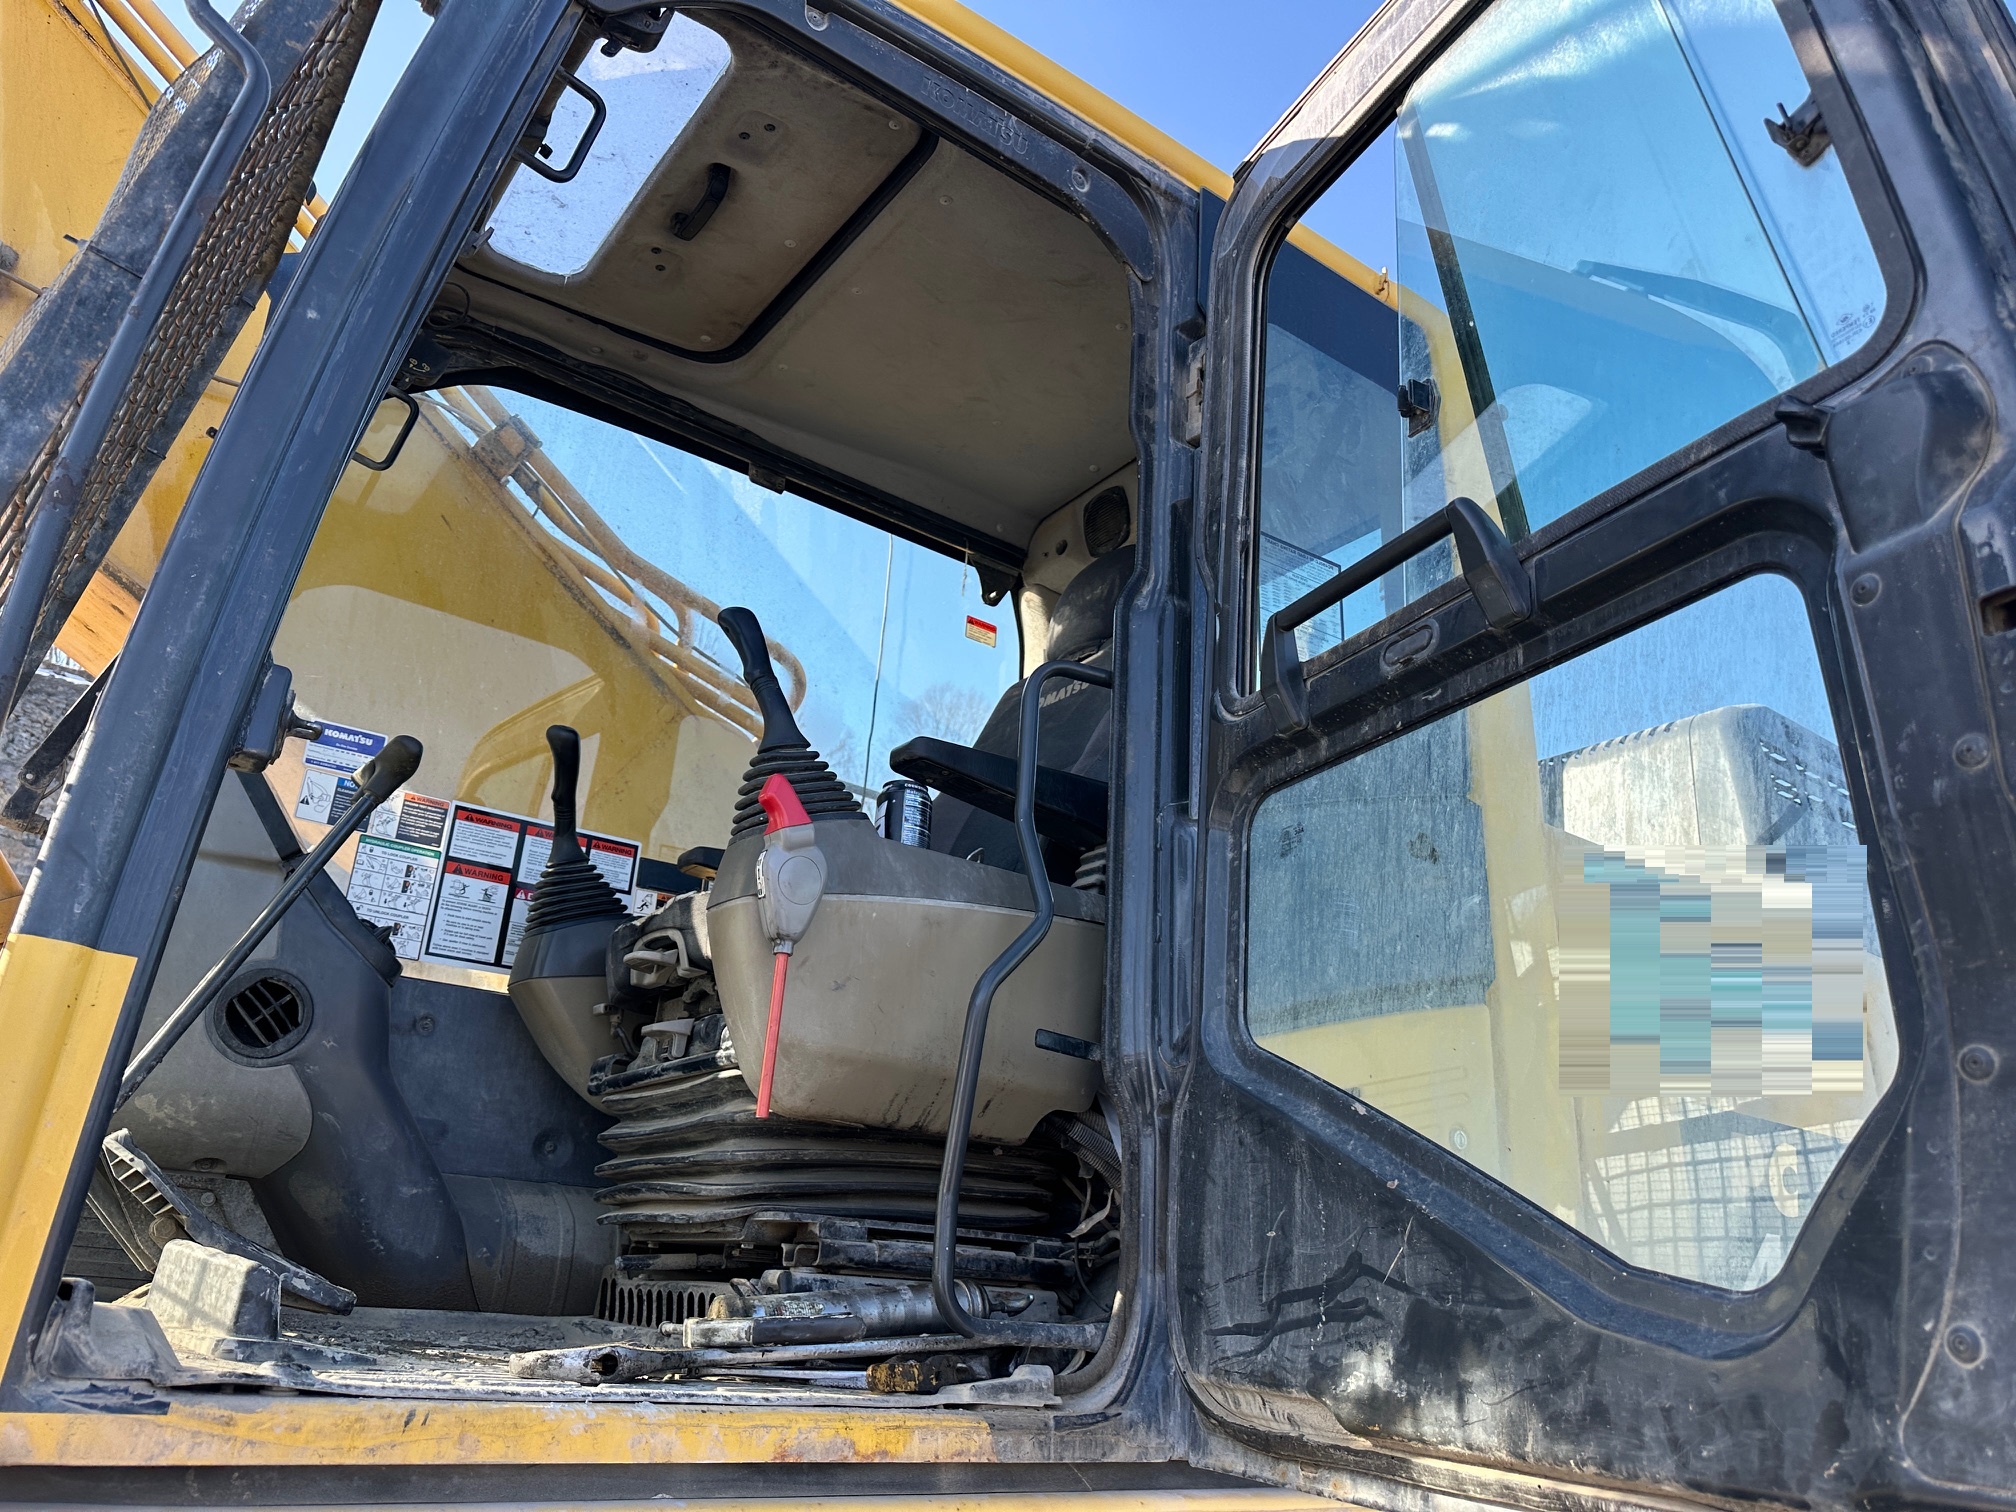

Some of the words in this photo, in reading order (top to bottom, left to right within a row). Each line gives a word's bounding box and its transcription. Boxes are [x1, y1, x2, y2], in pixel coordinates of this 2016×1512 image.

[920, 76, 1029, 155] KOMATSU
[324, 728, 374, 747] KOMATSU
[415, 797, 445, 807] WARNING
[475, 816, 513, 830] WARNING
[601, 843, 633, 856] WARNING
[464, 867, 504, 882] WARNING
